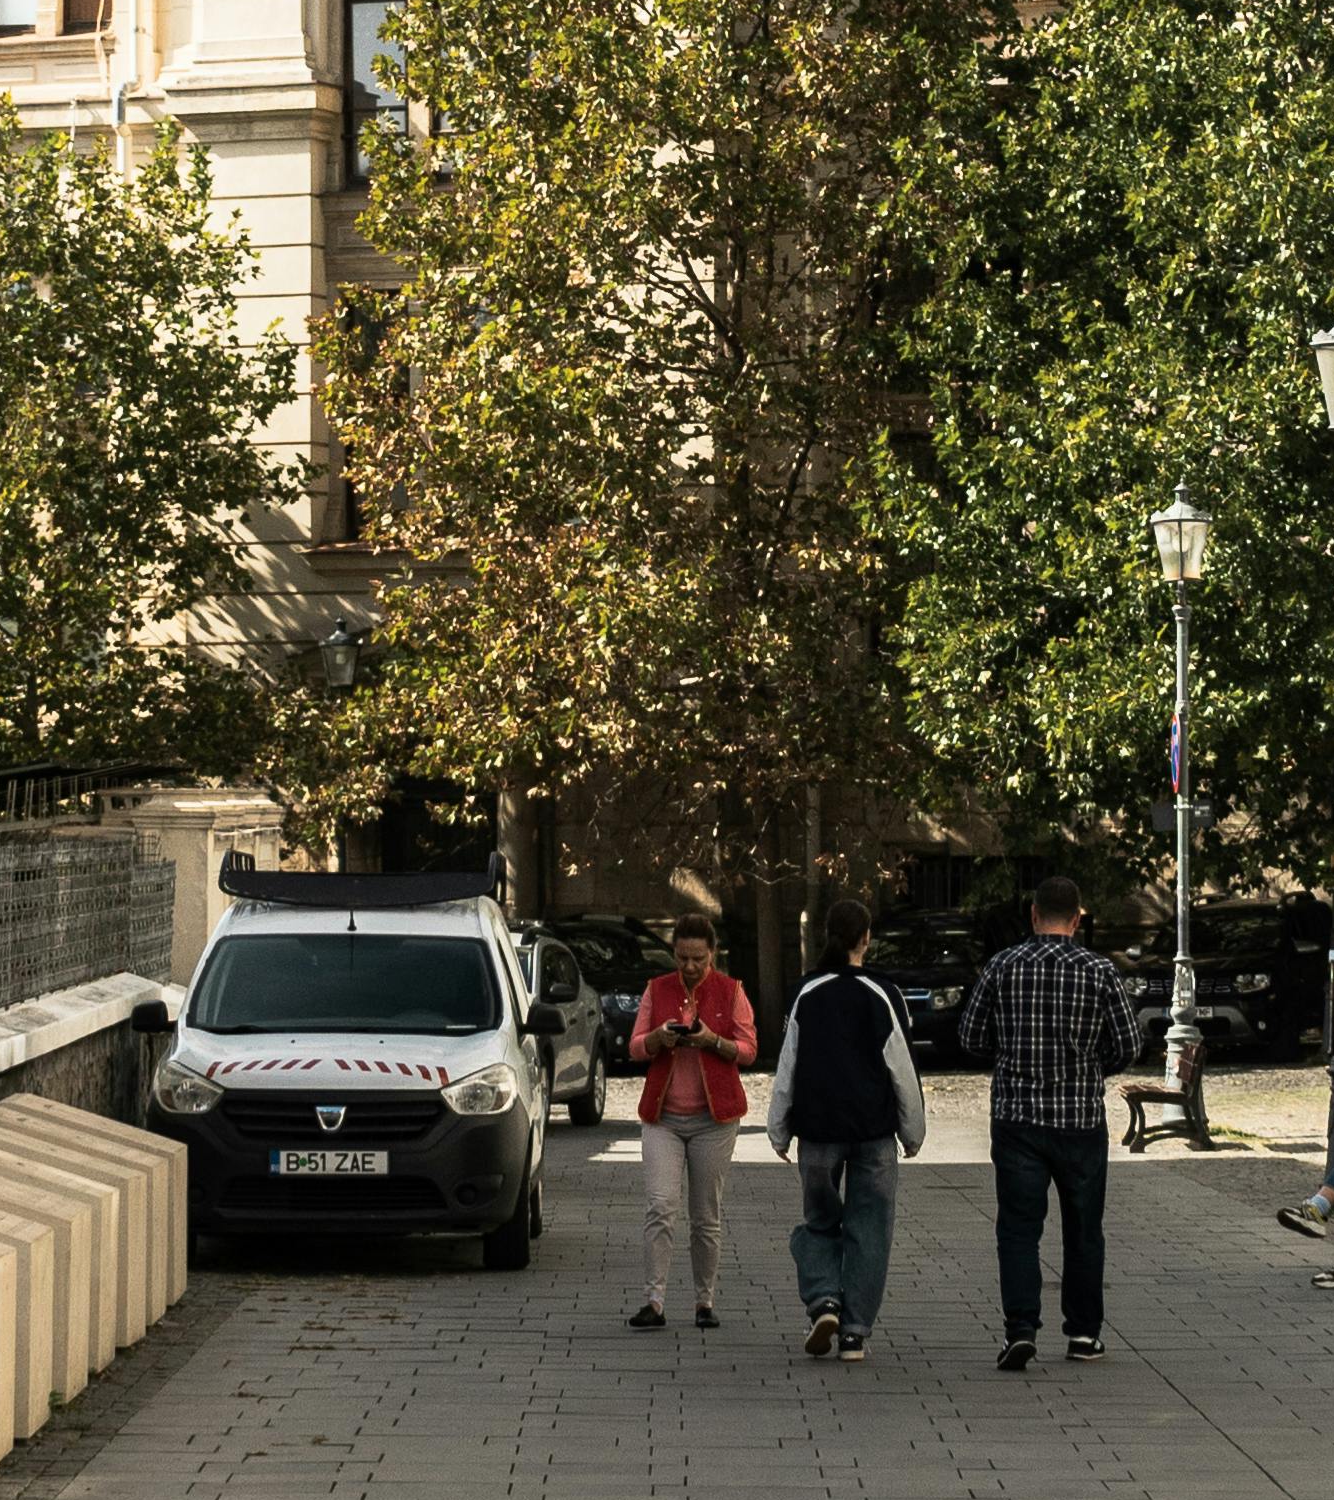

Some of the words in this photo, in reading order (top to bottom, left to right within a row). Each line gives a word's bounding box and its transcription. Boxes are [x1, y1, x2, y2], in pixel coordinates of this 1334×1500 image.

[286, 1153, 300, 1172] B
[307, 1153, 327, 1172] 51
[334, 1152, 375, 1172] ZAE
